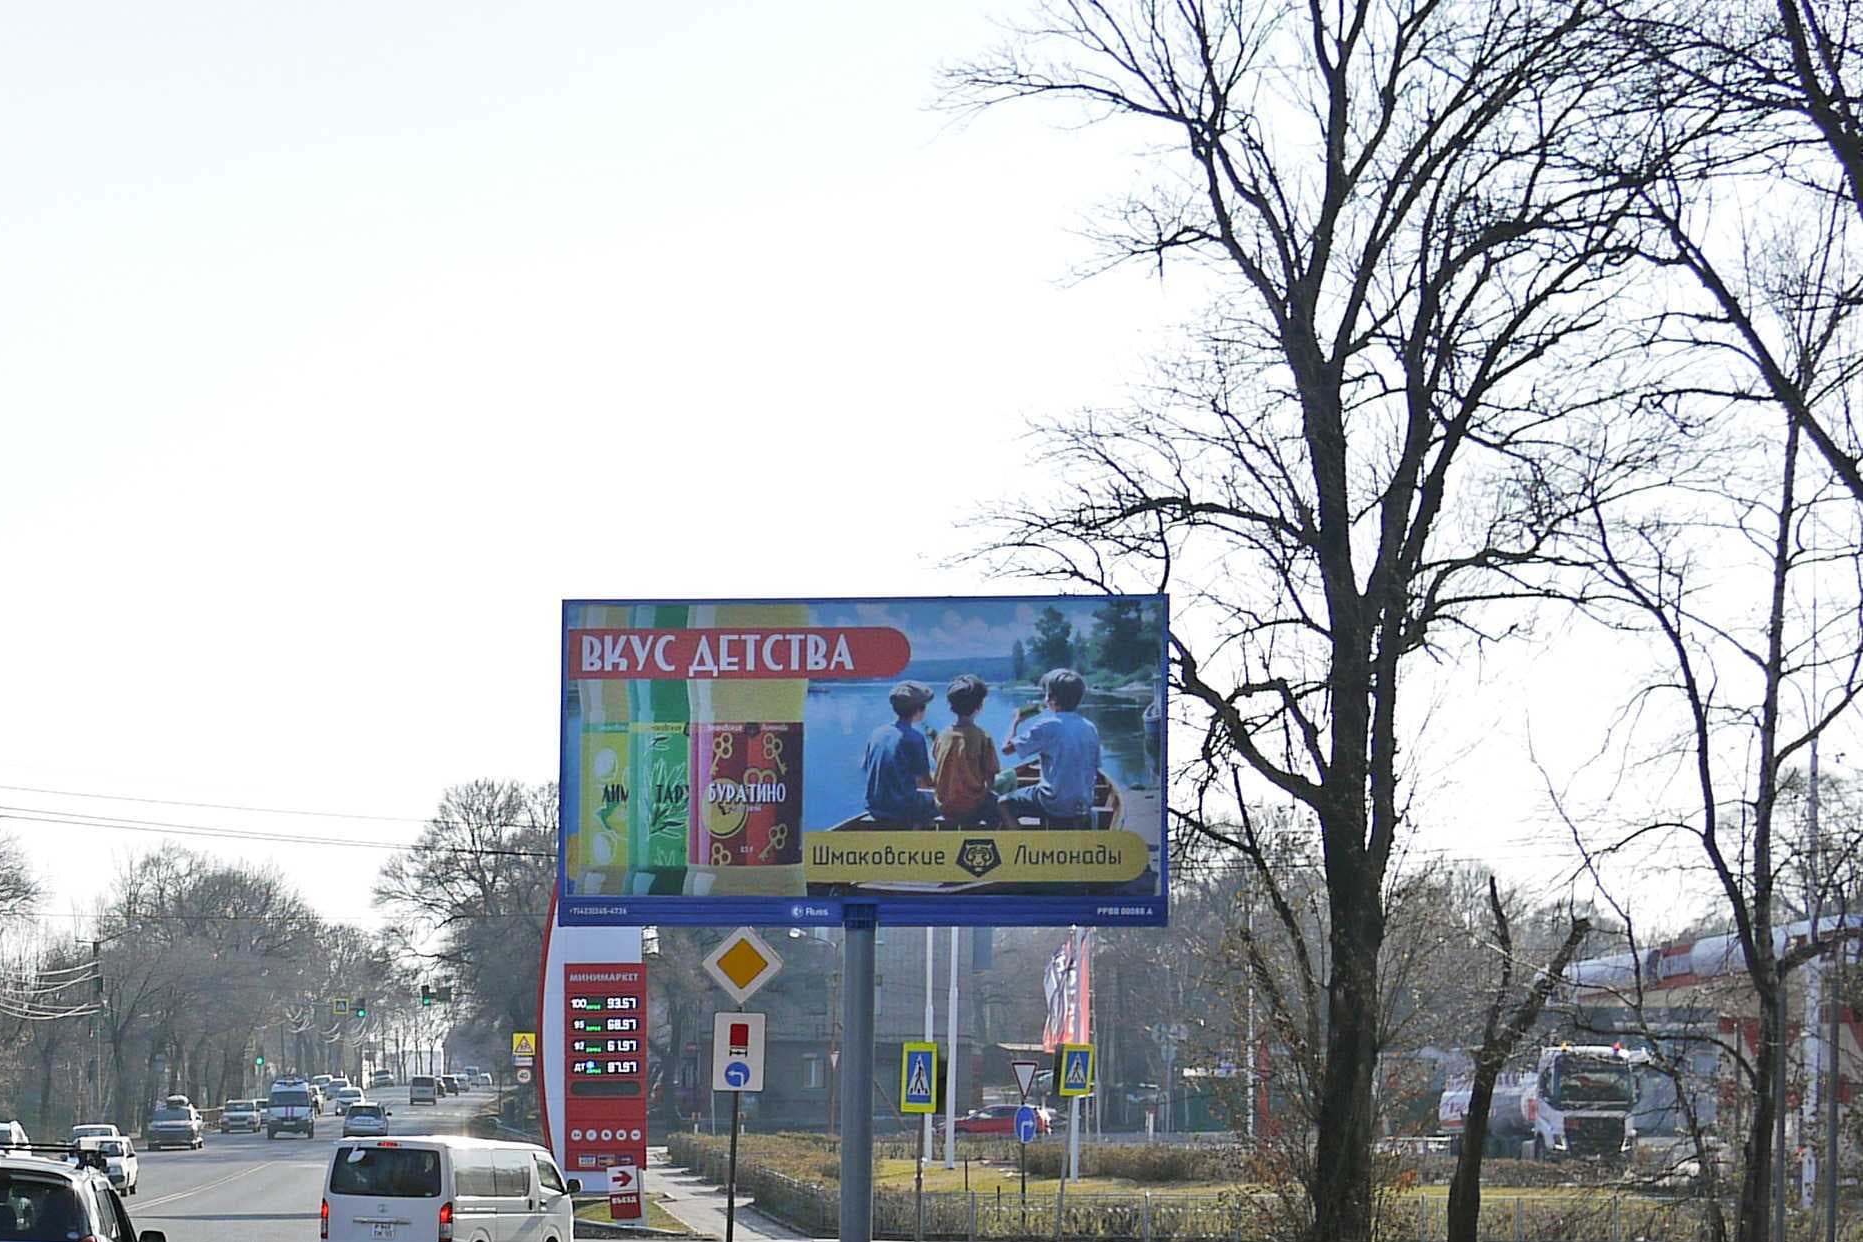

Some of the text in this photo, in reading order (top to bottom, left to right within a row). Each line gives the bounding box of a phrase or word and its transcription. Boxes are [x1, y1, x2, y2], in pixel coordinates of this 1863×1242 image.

[581, 634, 855, 678] ВКУС ДЕТСТВА
[708, 783, 786, 802] БУРАТИНО
[812, 845, 1122, 866] Шмаковские Лимонады
[569, 973, 638, 983] МИНИМАРКЕТ
[571, 998, 587, 1009] 100
[574, 1020, 585, 1029] 95
[574, 1041, 585, 1050] 92
[574, 1063, 585, 1072] ДТ
